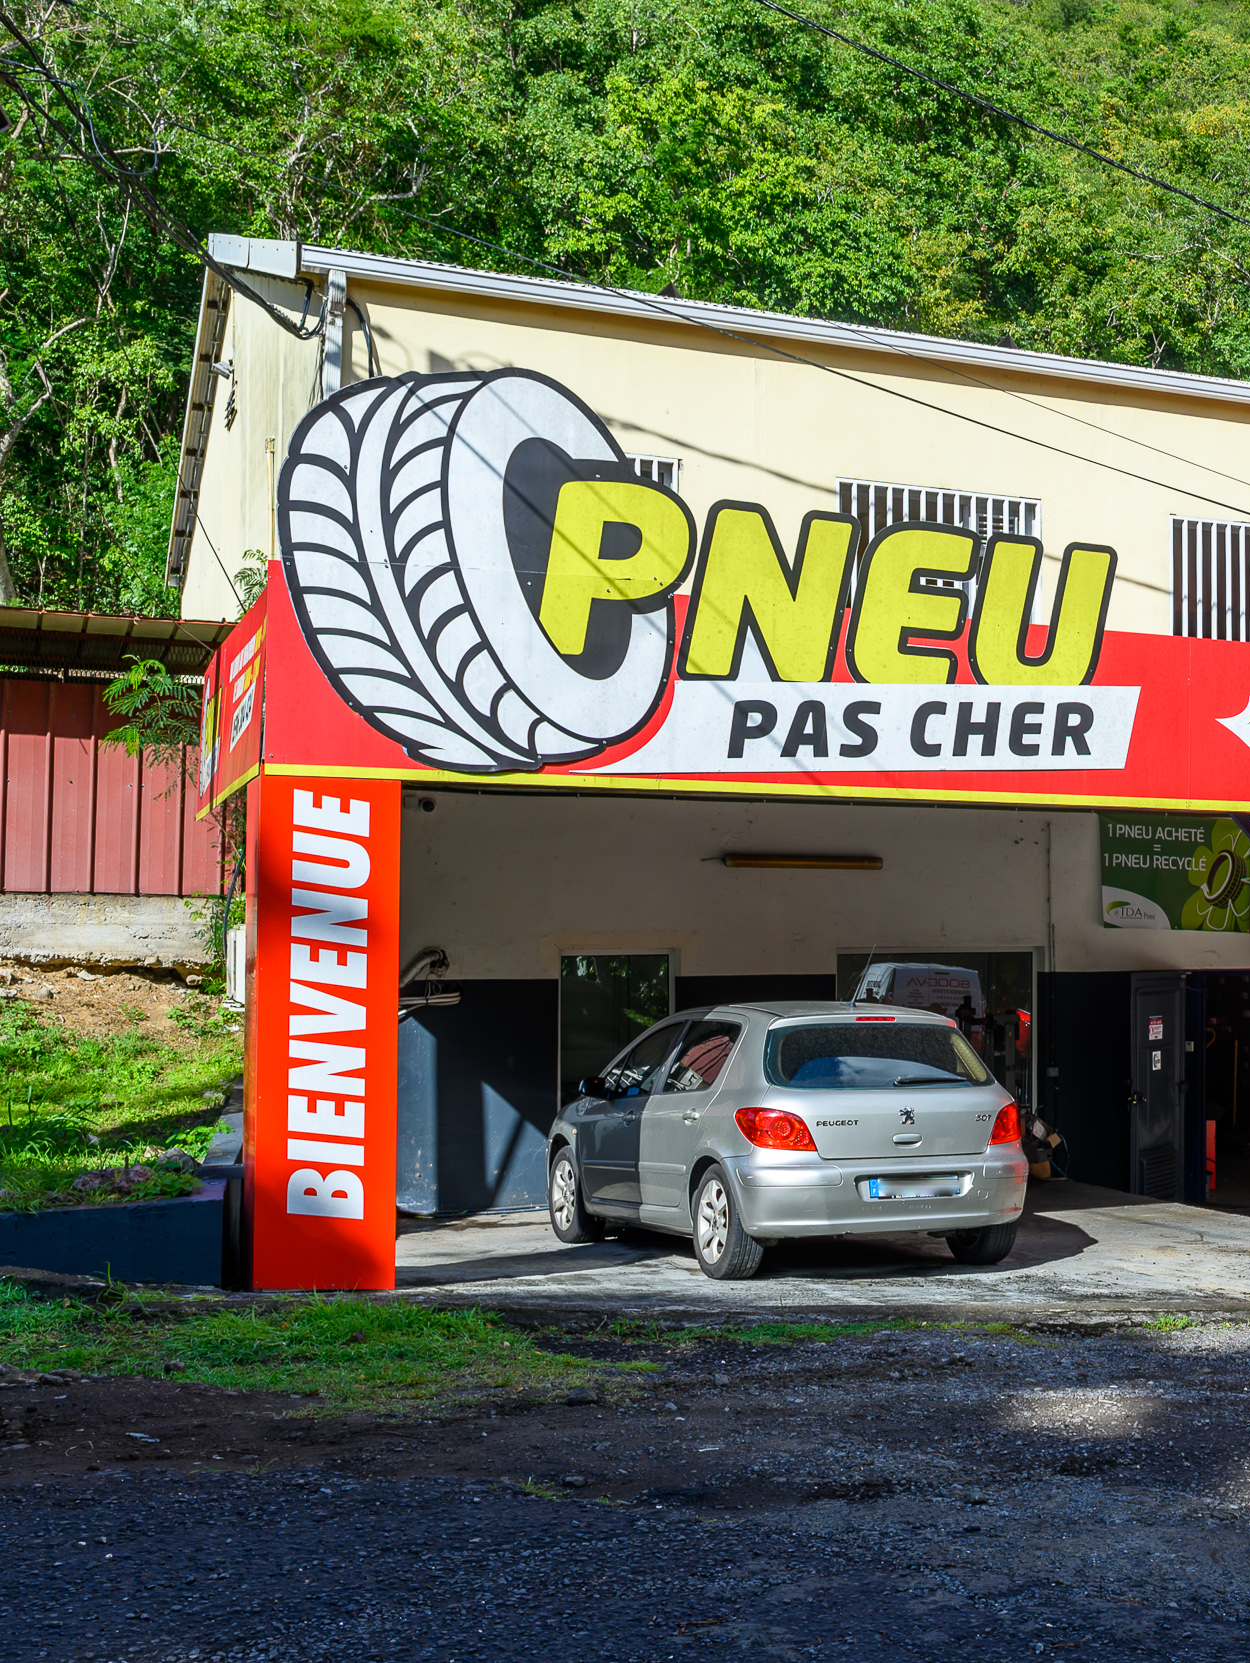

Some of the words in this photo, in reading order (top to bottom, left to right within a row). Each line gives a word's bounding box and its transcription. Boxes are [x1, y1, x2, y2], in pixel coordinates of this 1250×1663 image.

[535, 475, 1115, 688] PNEU
[727, 699, 882, 759] PAS
[910, 700, 1094, 758] CHER
[1107, 823, 1113, 838] 1
[1116, 824, 1152, 839] PNEU
[1155, 826, 1205, 843] ACHETÉ
[1103, 853, 1109, 867] 1
[1112, 853, 1150, 869] PNEU
[1153, 855, 1207, 872] RECYCLÉ
[286, 788, 371, 1220] BIENVENUE
[815, 1119, 859, 1127] PEUGEOT
[974, 1114, 992, 1122] 307
